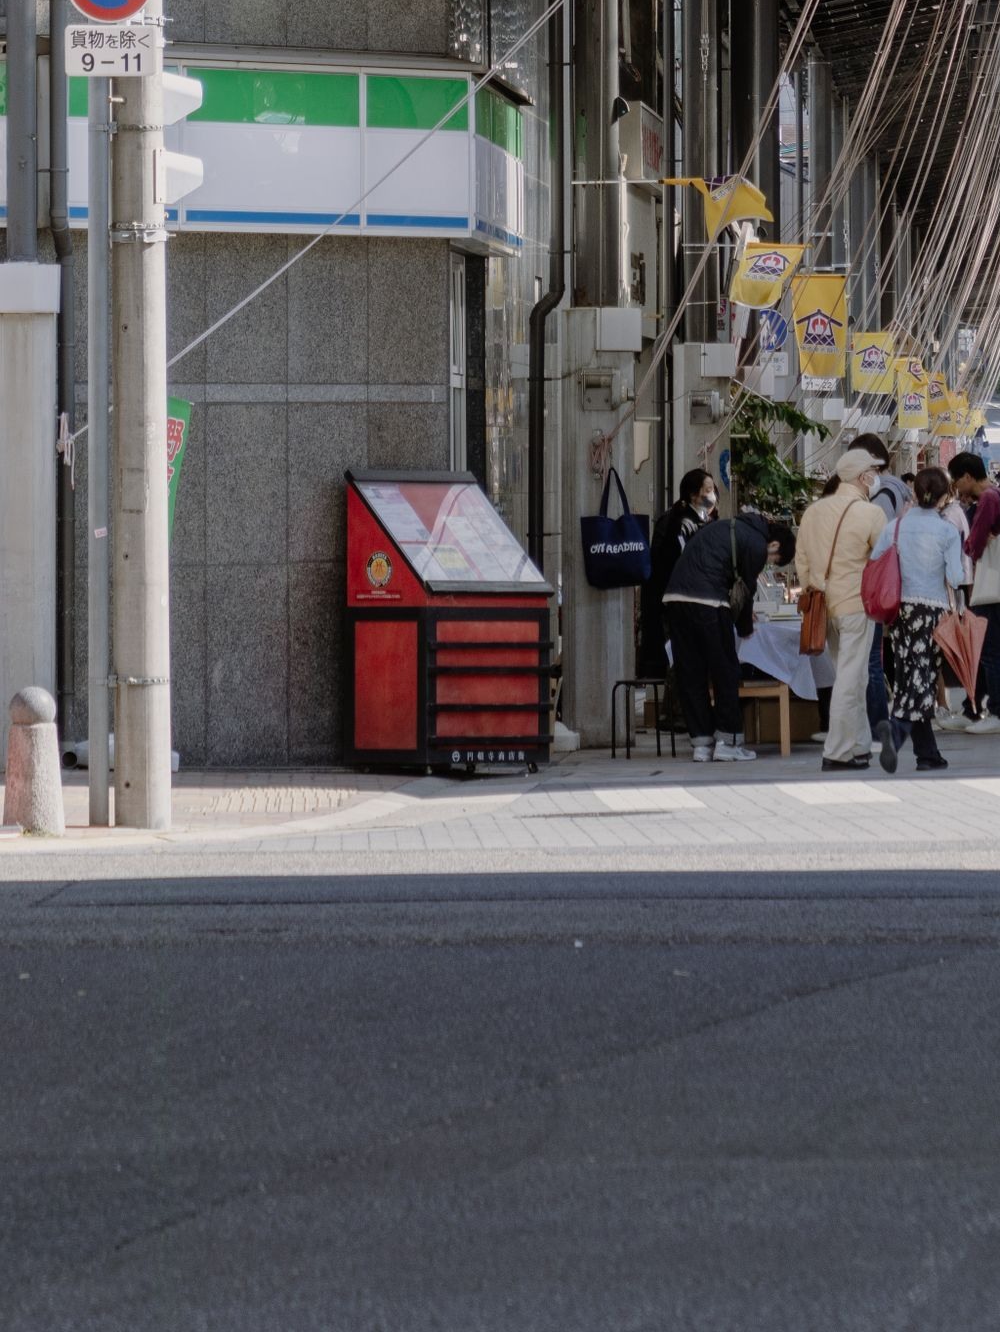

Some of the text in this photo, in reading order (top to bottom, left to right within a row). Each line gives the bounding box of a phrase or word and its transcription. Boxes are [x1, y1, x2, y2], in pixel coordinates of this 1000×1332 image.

[70, 30, 150, 50] 貨物を除く
